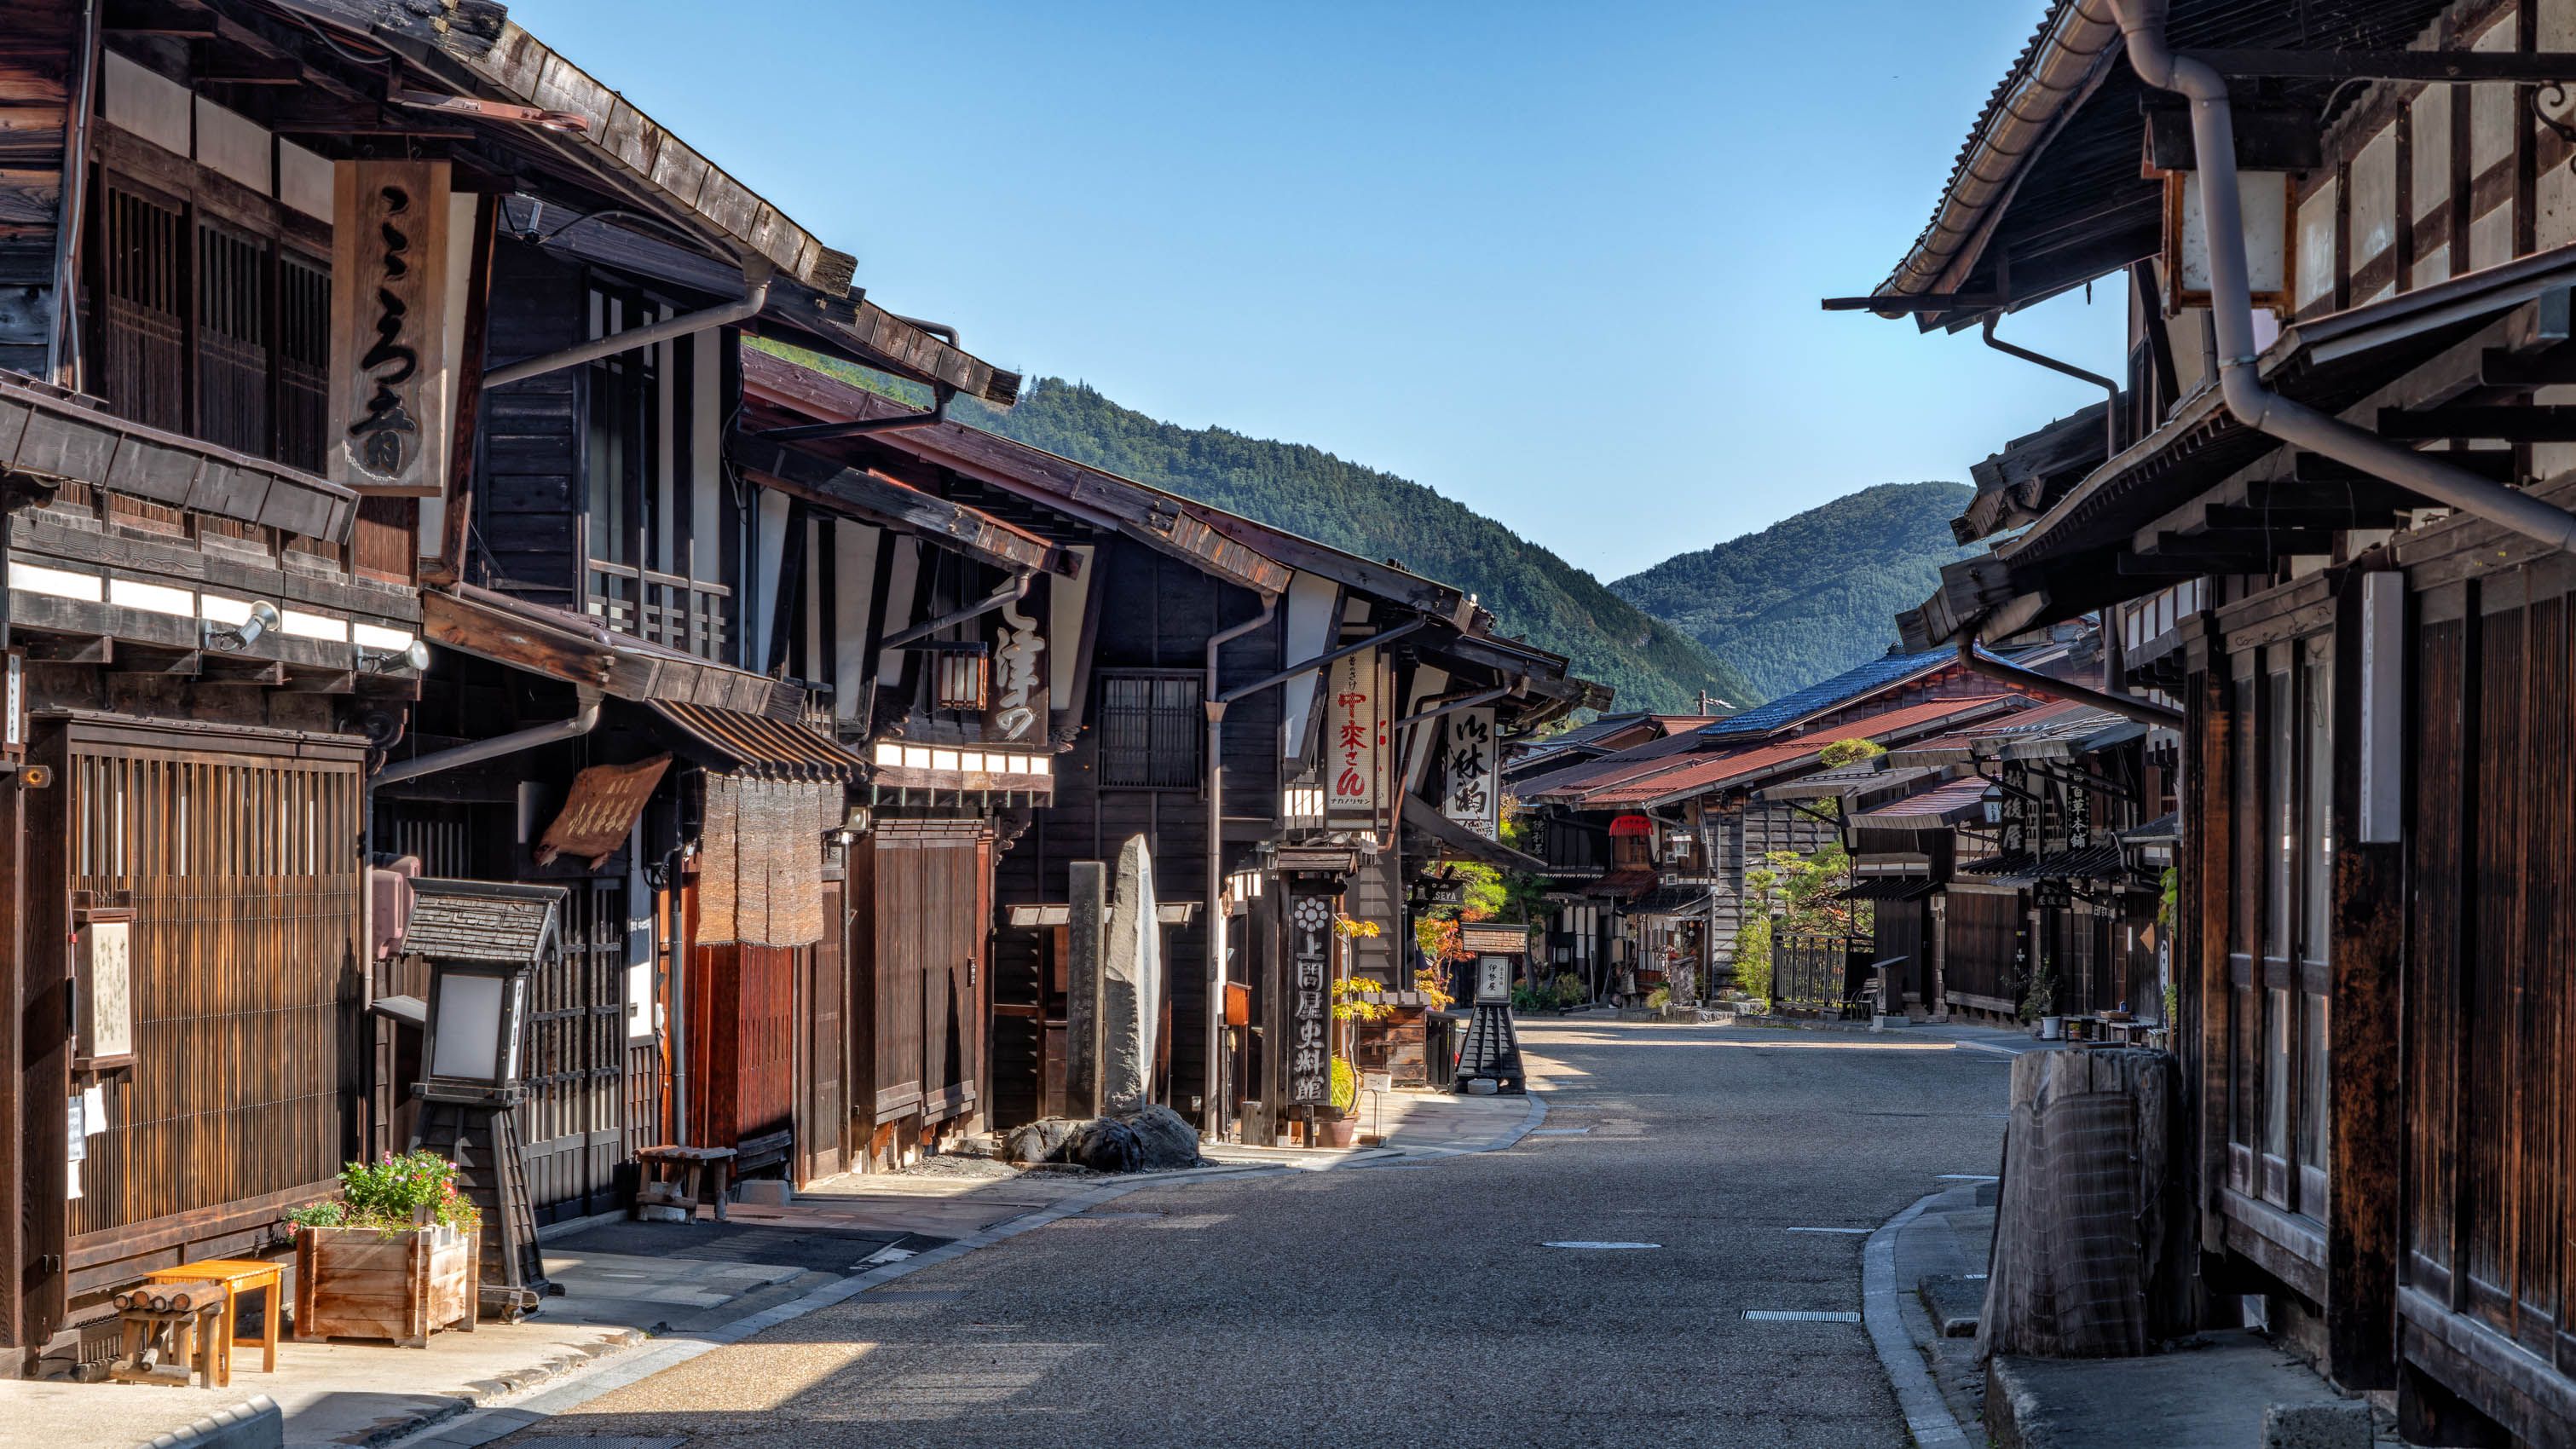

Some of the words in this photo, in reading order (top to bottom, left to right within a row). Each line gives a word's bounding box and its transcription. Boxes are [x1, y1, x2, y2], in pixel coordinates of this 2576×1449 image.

[1295, 933, 1325, 1100] 上問屋史料館
[1487, 964, 1498, 991] 伊勢屋
